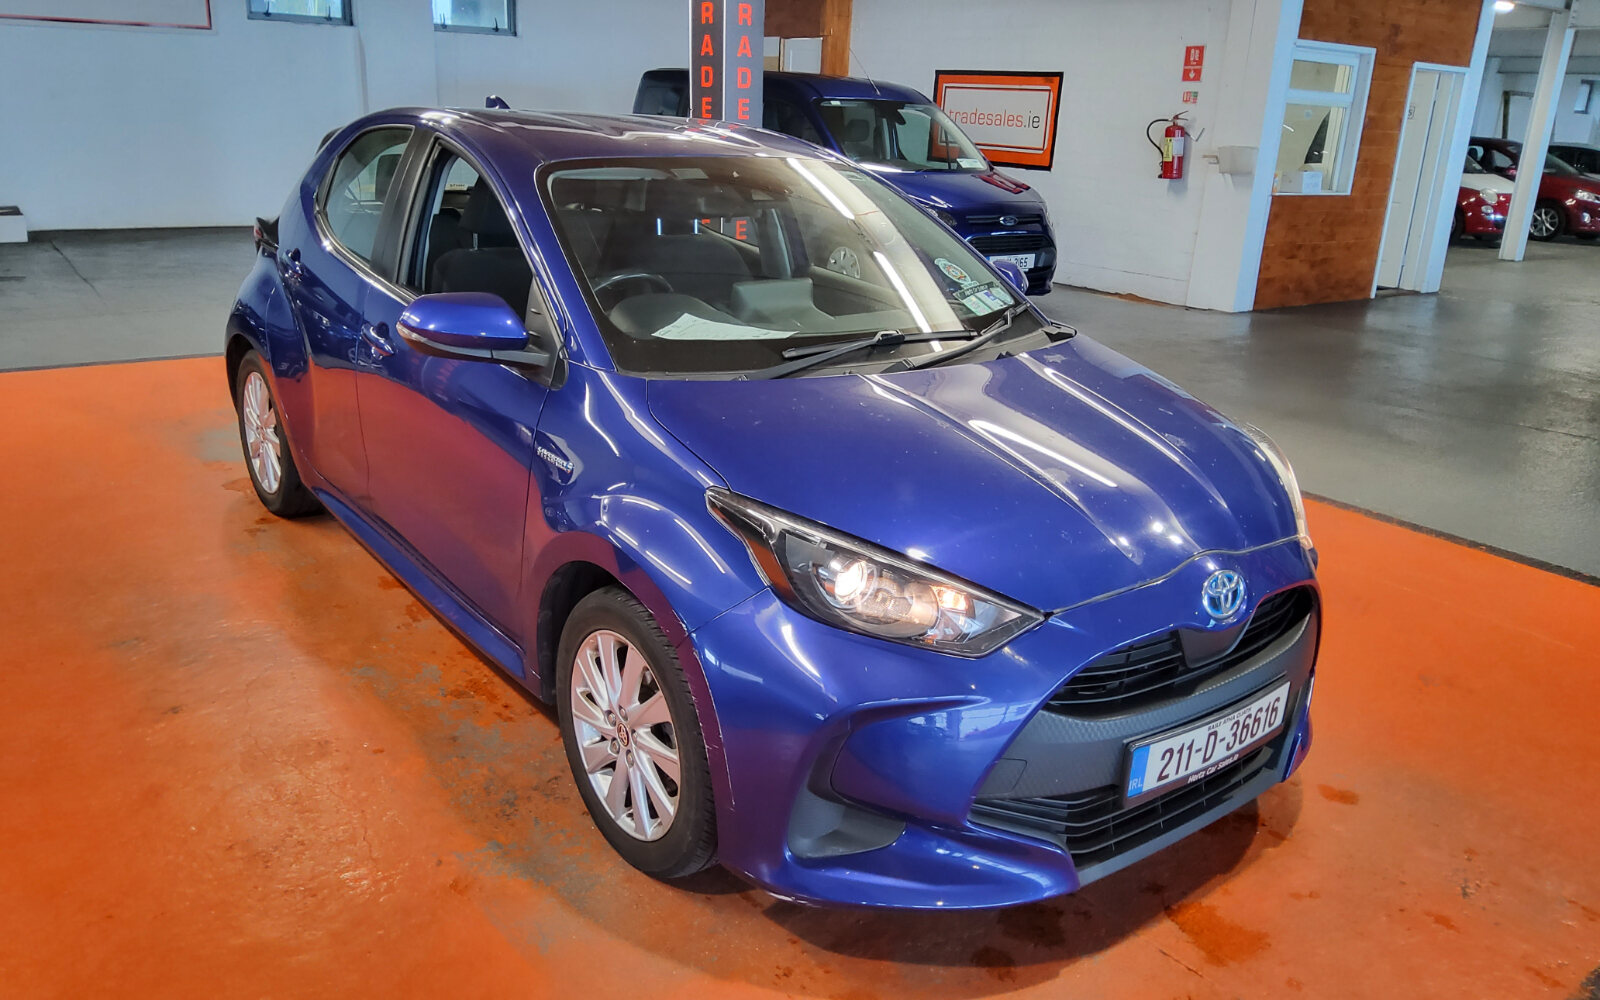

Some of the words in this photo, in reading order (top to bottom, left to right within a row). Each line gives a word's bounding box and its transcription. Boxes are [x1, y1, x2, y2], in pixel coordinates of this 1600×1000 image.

[949, 108, 1040, 129] tradesales.ie
[1156, 696, 1281, 783] 211-D-36616
[1187, 770, 1206, 783] Hertz
[1206, 763, 1218, 775] Car
[1128, 779, 1144, 791] IRL
